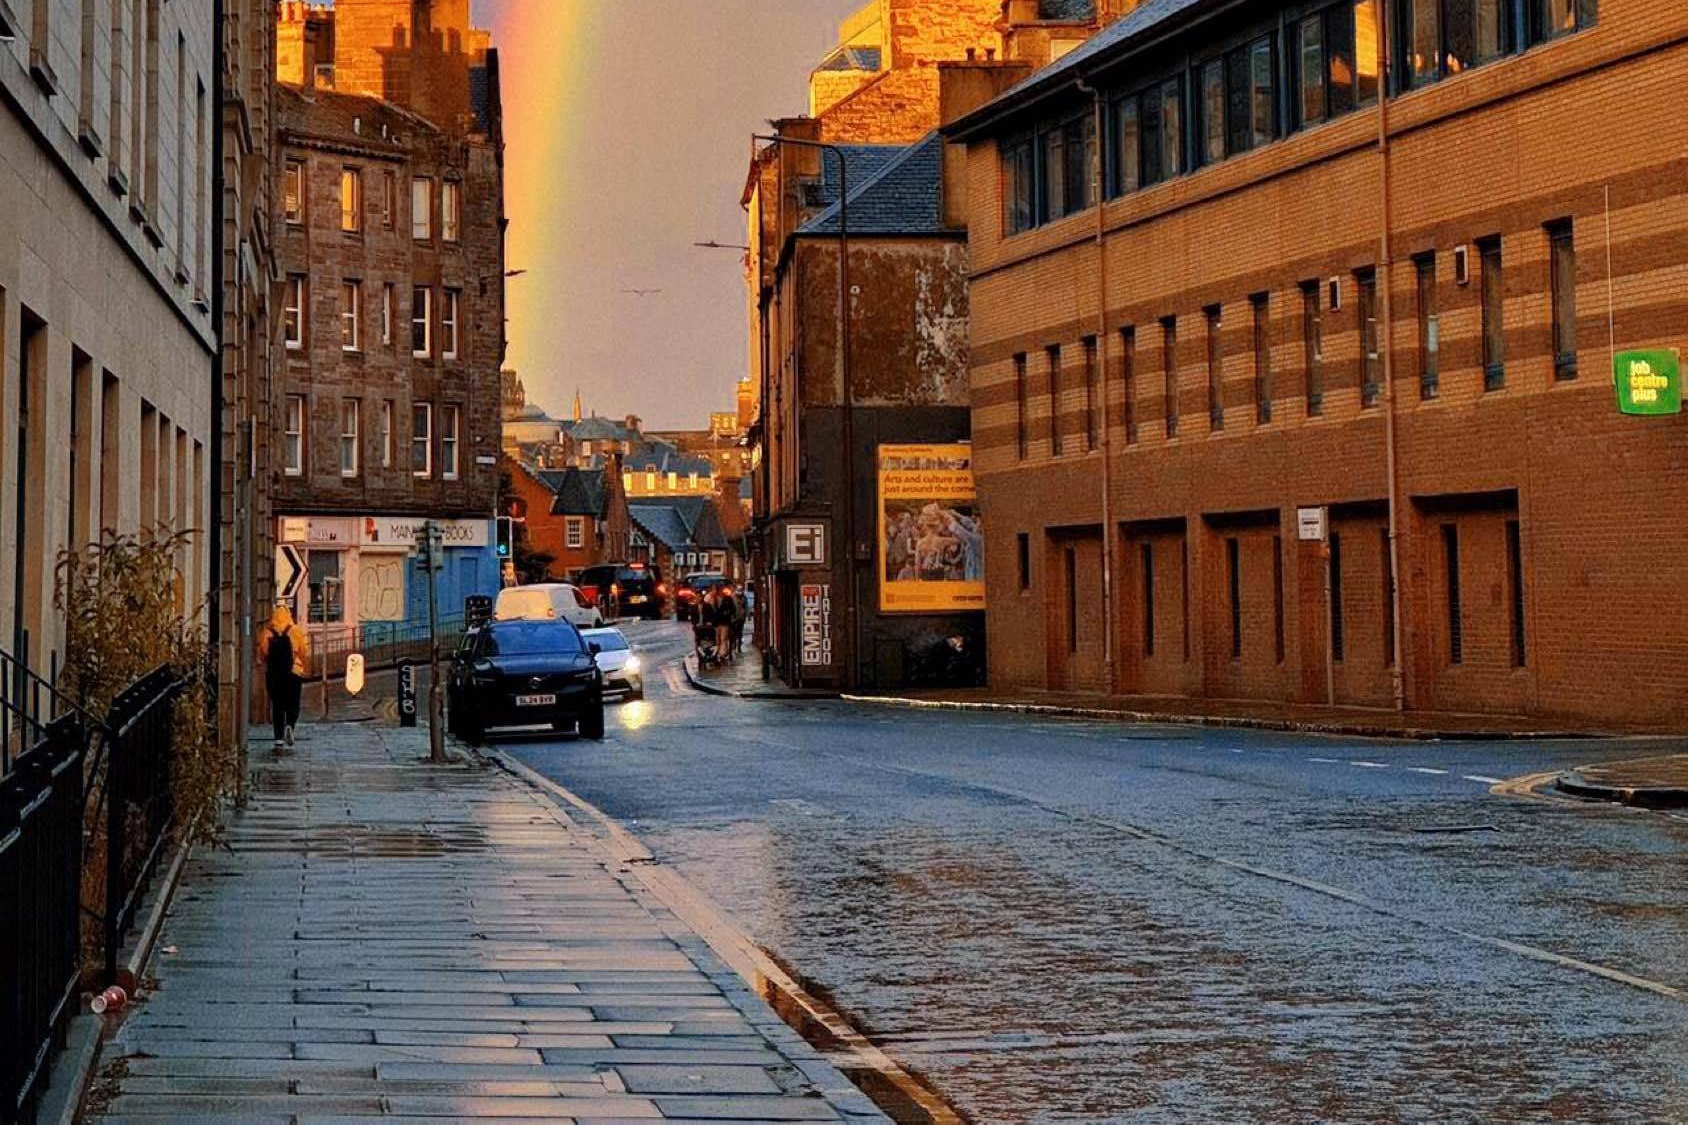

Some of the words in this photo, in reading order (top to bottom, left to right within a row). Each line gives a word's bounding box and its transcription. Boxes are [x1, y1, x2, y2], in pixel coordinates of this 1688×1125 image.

[1630, 359, 1651, 376] job
[1630, 373, 1668, 389] centre
[1632, 386, 1657, 403] plus
[904, 474, 921, 483] and
[923, 474, 953, 484] culture
[883, 485, 900, 494] just
[902, 484, 933, 493] around
[935, 484, 949, 493] the
[445, 525, 474, 540] BOOKS
[804, 595, 820, 663] EMPIRE
[822, 585, 832, 665] TATTOO
